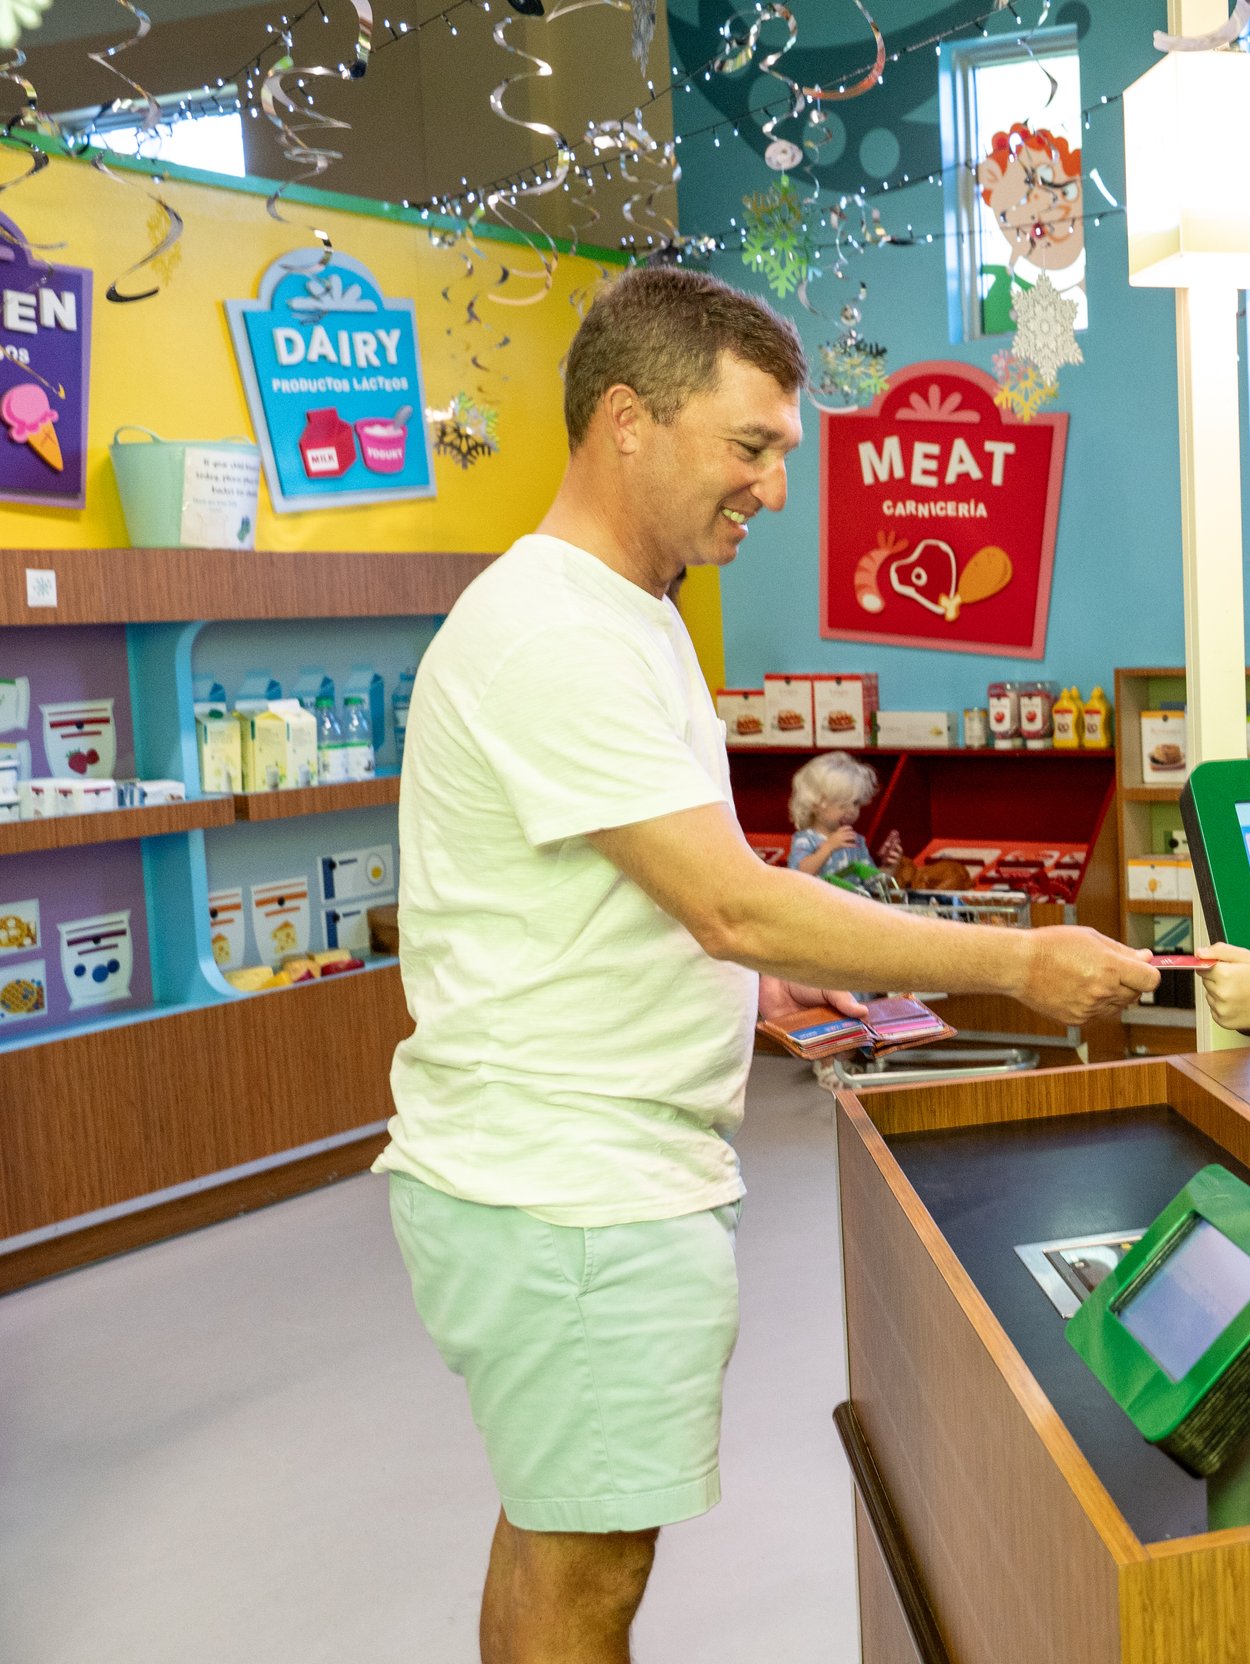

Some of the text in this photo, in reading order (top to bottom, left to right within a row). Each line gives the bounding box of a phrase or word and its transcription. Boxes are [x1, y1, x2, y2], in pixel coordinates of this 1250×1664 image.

[272, 325, 401, 369] DAIRY
[271, 376, 351, 394] PRODUCTOS
[311, 454, 335, 464] MILK
[367, 446, 403, 460] YOGURT
[858, 435, 1016, 488] MEAT
[883, 498, 988, 518] CARNICERÍA
